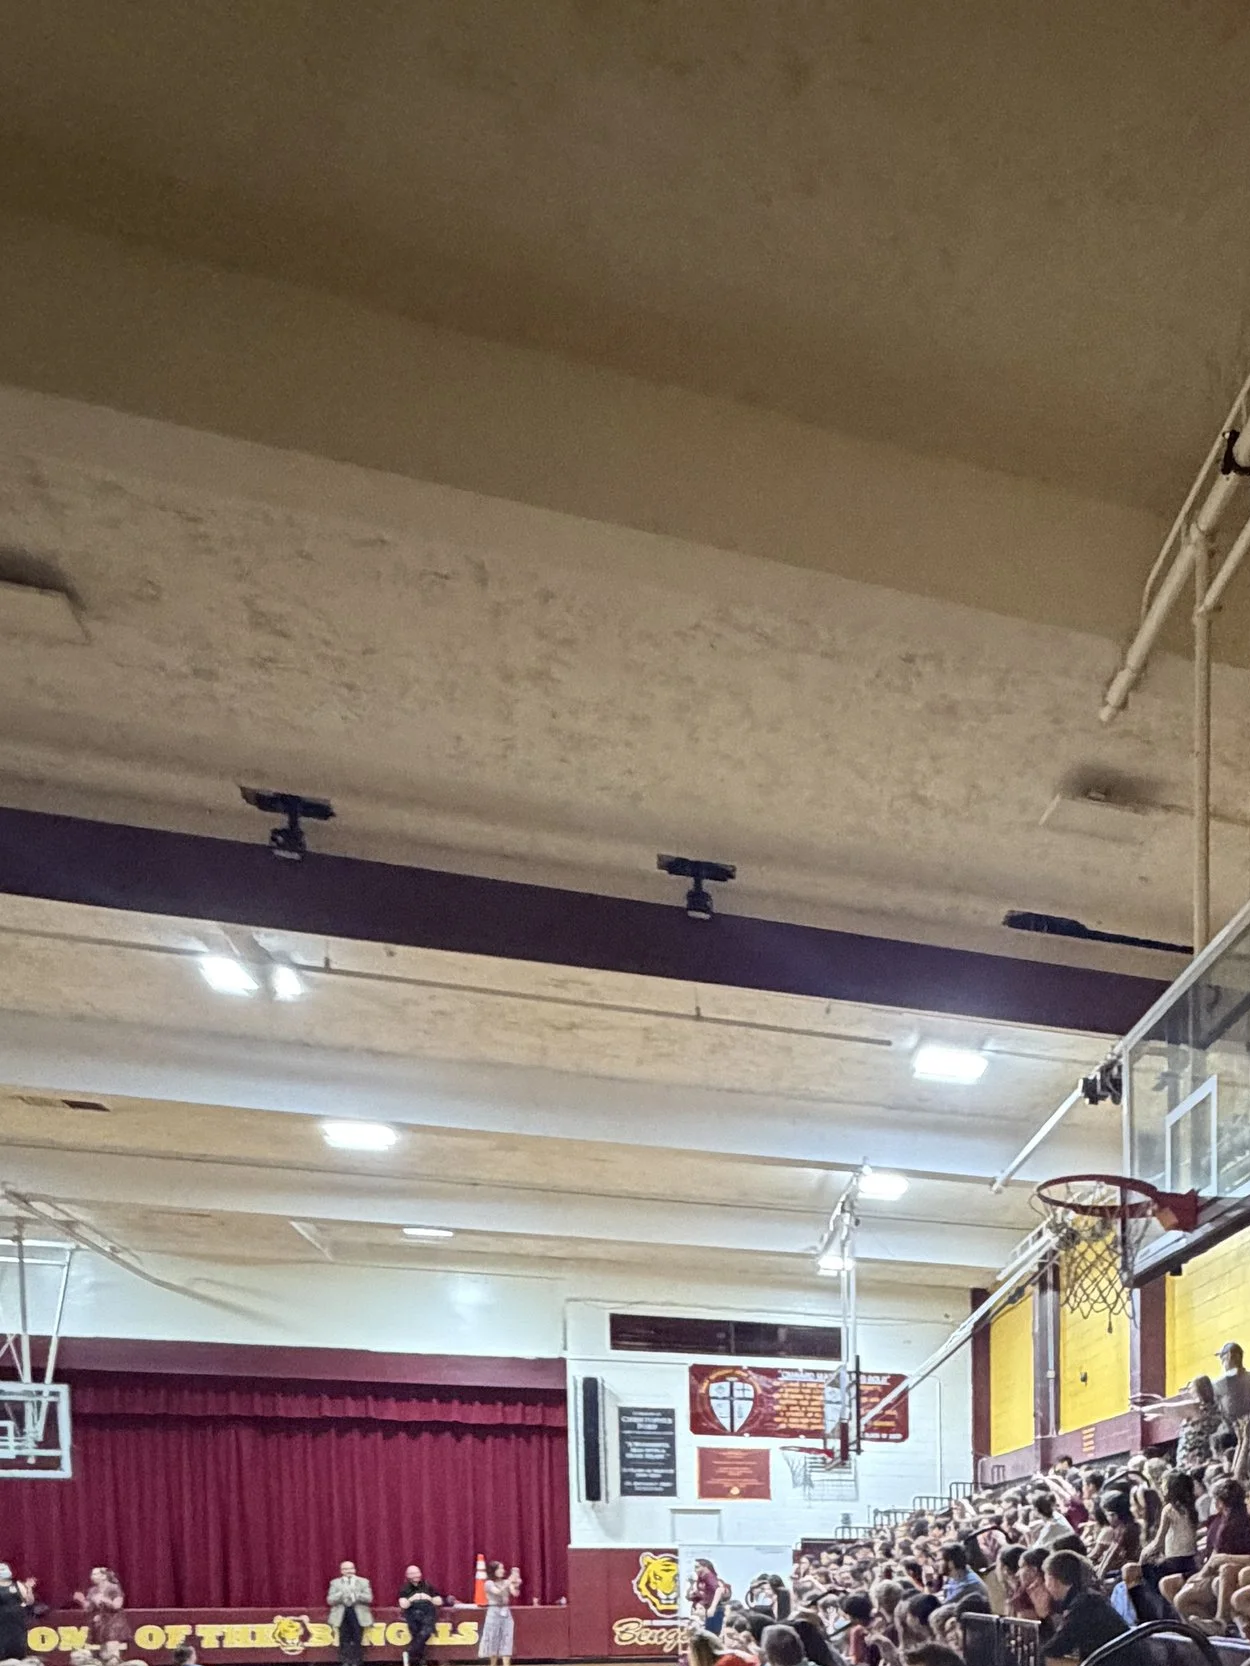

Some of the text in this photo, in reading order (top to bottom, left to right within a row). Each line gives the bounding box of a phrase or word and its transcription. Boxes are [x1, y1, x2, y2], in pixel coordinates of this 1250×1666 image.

[27, 1626, 127, 1651] OM
[134, 1624, 192, 1650] OF
[304, 1622, 479, 1647] BNGLS
